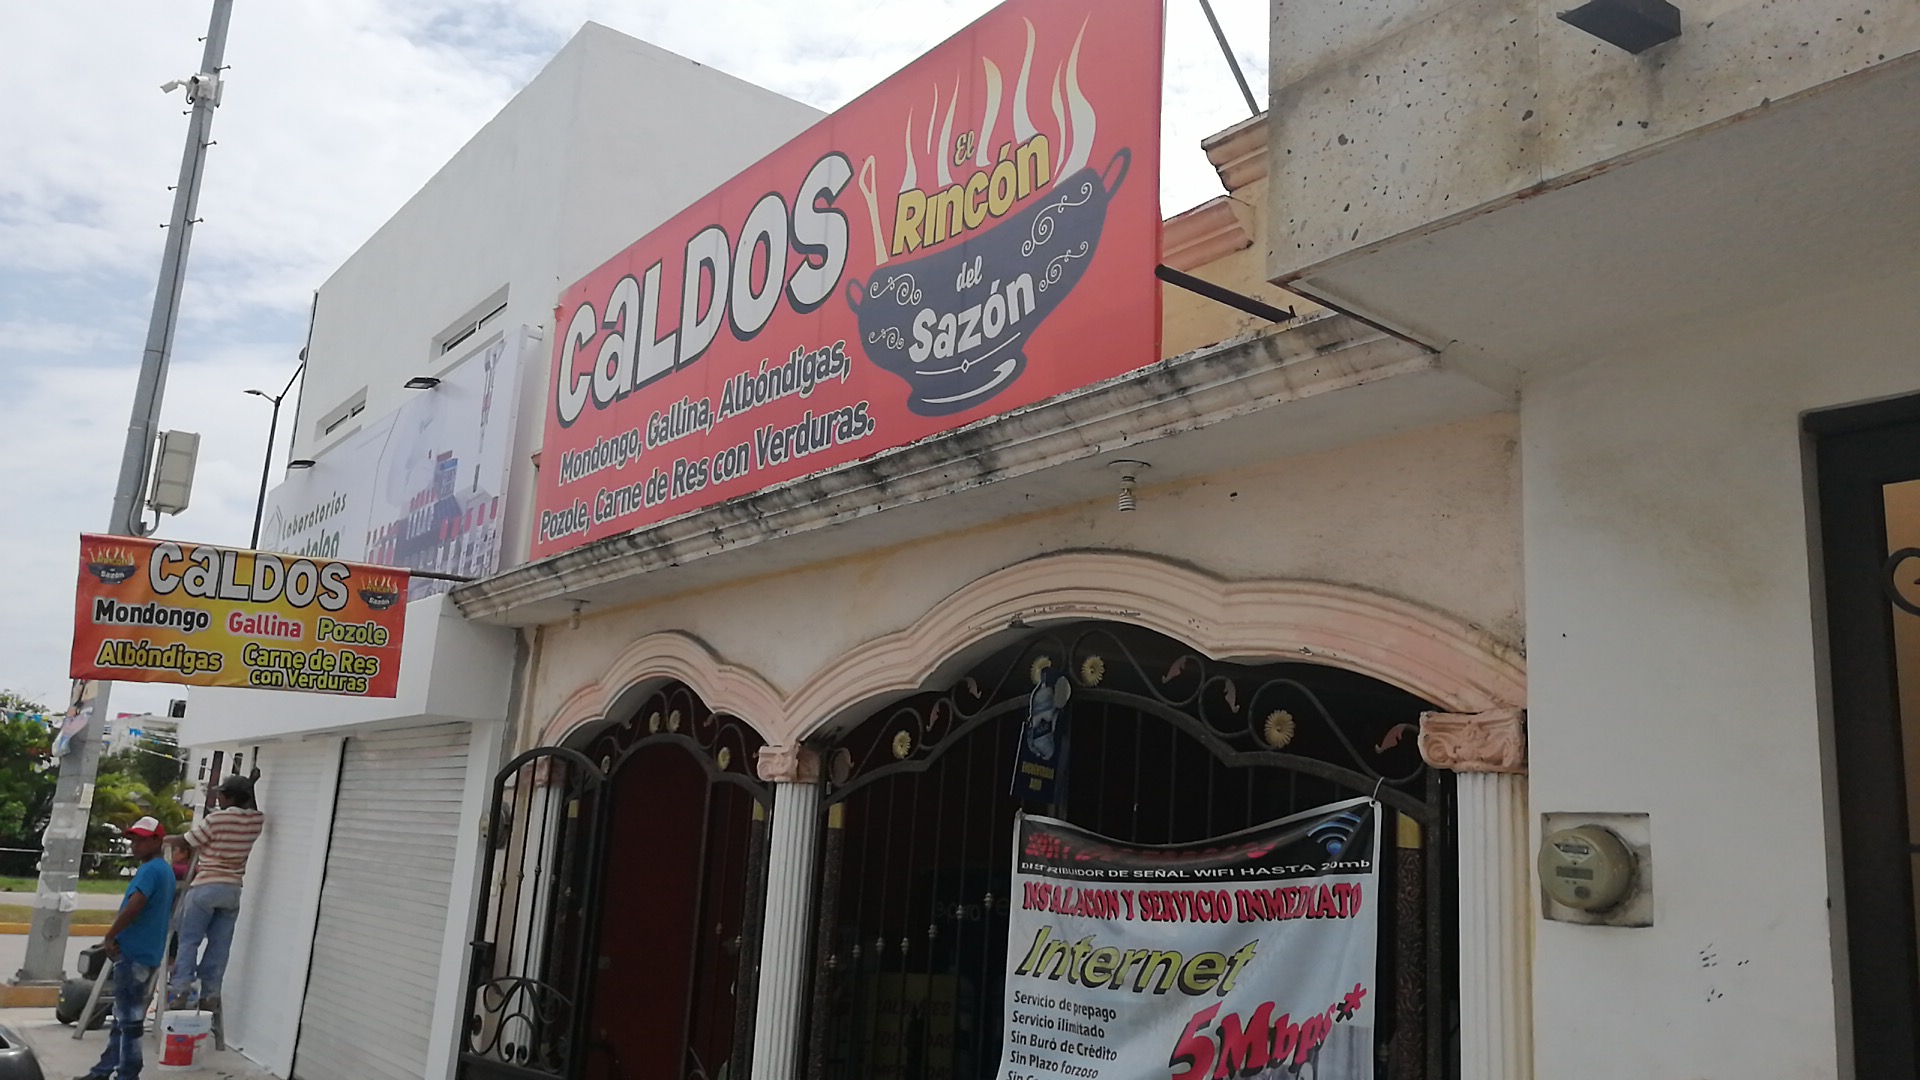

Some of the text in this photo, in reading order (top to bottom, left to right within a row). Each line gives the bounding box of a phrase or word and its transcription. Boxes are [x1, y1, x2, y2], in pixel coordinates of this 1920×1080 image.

[953, 130, 975, 167] El
[890, 133, 1051, 257] Rincón
[956, 255, 983, 293] del
[908, 272, 1036, 364] Sazón
[558, 340, 851, 487] Mondongo, Gallina, Albóndigas,
[538, 400, 876, 545] Pozole, Carne de Res con Verduras.
[95, 599, 388, 645] Mondongo Gallina Pozole
[95, 640, 378, 675] Albóndigas Carne de Res
[249, 667, 368, 693] con Verduras
[1108, 869, 1129, 878] DE
[1133, 868, 1190, 878] SEÑAL
[1194, 868, 1235, 877] WIFI
[1240, 864, 1316, 876] HASTA
[1321, 859, 1371, 871] 20mb
[1120, 889, 1135, 921] Y
[1139, 889, 1233, 923] SERVICIO
[1235, 882, 1362, 923] INMEDIATO
[1014, 925, 1260, 997] Internet
[1012, 1010, 1105, 1038] Servicio ilimitado
[1014, 990, 1117, 1022] Servicio de prepago
[1011, 1030, 1027, 1045] Sin
[1060, 1040, 1075, 1054] de
[1077, 1043, 1118, 1061] Crédito
[1010, 1050, 1099, 1079] Sin Plazo forzoso
